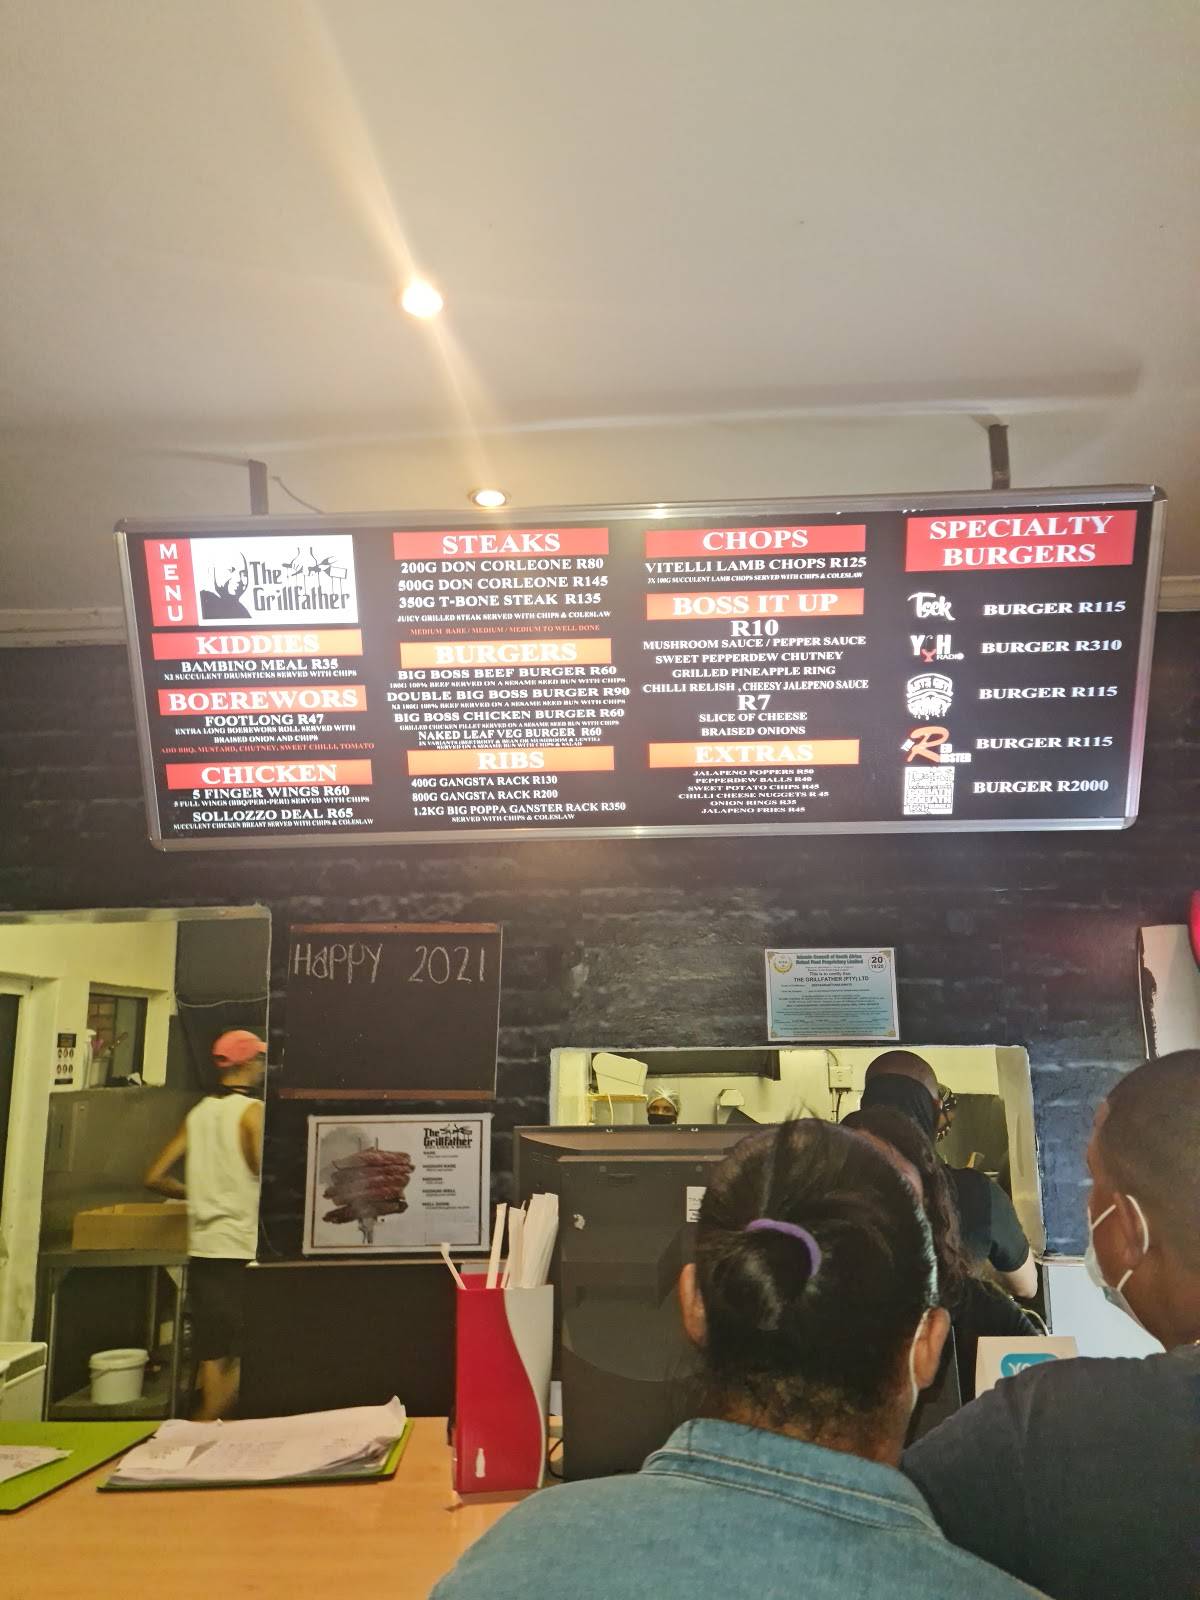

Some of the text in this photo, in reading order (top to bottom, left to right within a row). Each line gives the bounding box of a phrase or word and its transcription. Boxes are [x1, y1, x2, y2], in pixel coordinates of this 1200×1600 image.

[929, 516, 1114, 540] SPECIALTY
[442, 533, 561, 555] STEAKS
[703, 529, 809, 551] CHOPS
[943, 544, 1096, 566] BURGERS
[401, 558, 604, 573] 200G DON CORLEONE R80
[645, 557, 867, 573] VITELLI LAMB CHOPS R125
[250, 561, 282, 585] The
[159, 544, 184, 621] MENU
[399, 576, 608, 591] 500G DON CORLEONE R145
[253, 585, 350, 611] Grillfather
[399, 593, 601, 608] 350G T-BONE STEAK R135
[673, 593, 839, 616] BOSS IT UP
[983, 601, 1126, 616] BURGER R115
[731, 619, 779, 636] R10
[196, 633, 320, 655] KIDDIES
[643, 639, 719, 650] MUSHROOM
[722, 639, 763, 648] SAUCE
[773, 637, 820, 647] PEPPER
[823, 636, 866, 646] SAUCE
[981, 639, 1123, 654] BURGER R310
[435, 643, 577, 664] BURGERS
[656, 651, 843, 664] SWEET PEPPERDEW CHUTNEY
[181, 658, 338, 673] BAMBINO MEAL R35
[398, 666, 617, 680] BIG BOSS BEEF BURGER R60
[672, 666, 836, 678] GRILLED PINEAPPLE RING
[387, 687, 630, 701] DOUBLE BIG BOSS BURGER R90
[642, 680, 869, 693] CHILLI RELISH CHEESY JALEPENO SAUCE
[979, 686, 1118, 700] BURGER R115
[168, 689, 359, 711] BOEREWORS
[737, 695, 771, 711] R7
[205, 714, 324, 727] FOOTLONG R47
[394, 709, 625, 723] BIG BOSS CHICKEN BURGER R60
[699, 712, 808, 722] SLICE OF CHEESE
[418, 727, 602, 740] NAKED LEAF VEG BURGER R60
[701, 726, 806, 736] BRAISED ONIONS
[976, 737, 1113, 750] BURGER R115
[478, 752, 545, 770] RIBS
[695, 745, 814, 763] EXTRAS
[201, 764, 337, 785] CHICKEN
[411, 776, 558, 788] 400G GANGSTA RACK R130
[193, 786, 350, 799] 5 FINGER WINGS R60
[973, 779, 1109, 794] BURGER R2000
[412, 790, 558, 802] 800G GANGSTA RACK R200
[193, 808, 353, 822] SOLLOZZO DEAL R65
[414, 802, 626, 816] 1.2KG BIG POPPA GANSTER RACK R350
[408, 946, 485, 984] 2021
[424, 1128, 439, 1136] The
[424, 1136, 472, 1147] Grillfather
